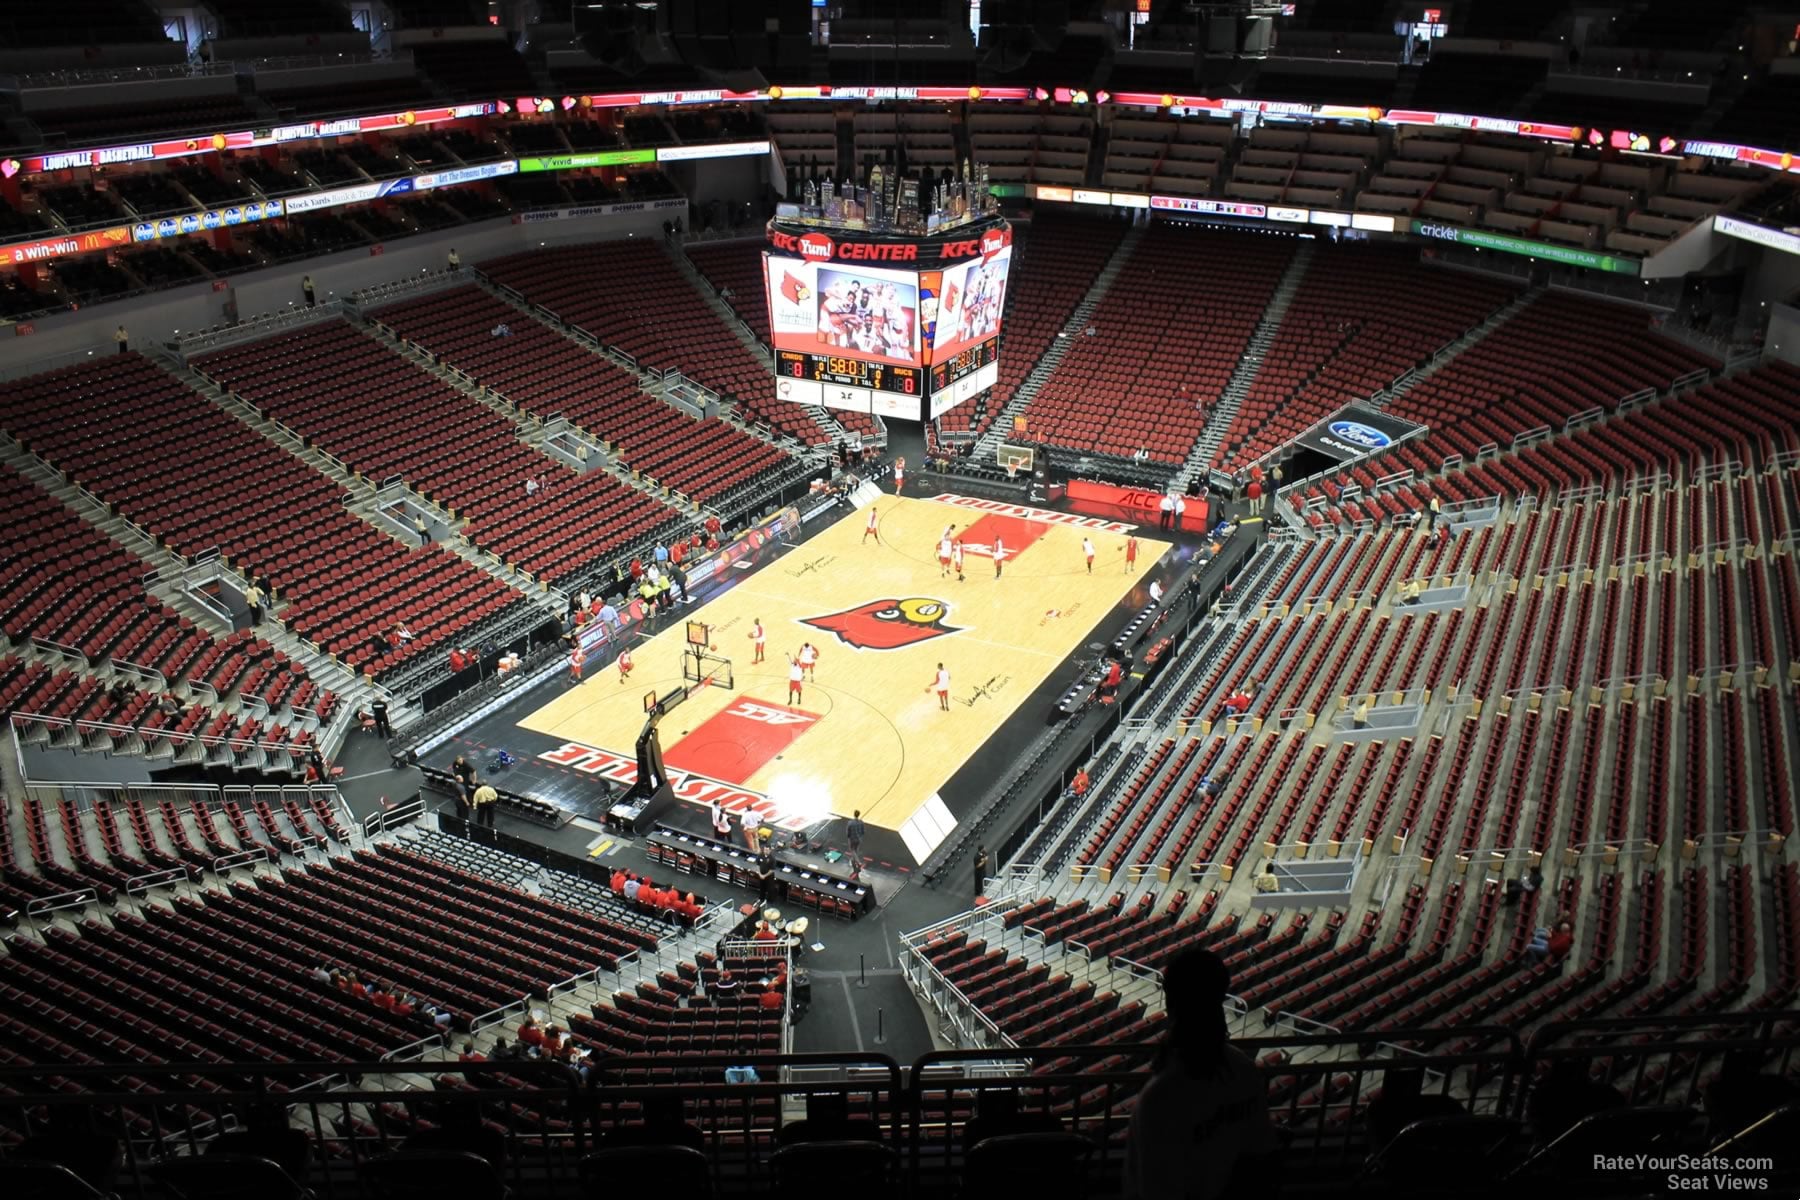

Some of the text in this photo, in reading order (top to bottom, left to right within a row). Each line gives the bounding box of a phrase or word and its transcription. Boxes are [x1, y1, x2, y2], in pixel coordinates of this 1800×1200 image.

[277, 119, 360, 141] LOUISVILLE BASKETBALL
[1477, 118, 1519, 133] BASKETBALL
[43, 145, 155, 171] LOUISVILLE BASKETBALL
[1684, 142, 1738, 159] BASKETBALL
[288, 200, 310, 209] Stock
[310, 197, 331, 207] Yards
[15, 249, 24, 261] a
[25, 238, 79, 260] win-win
[773, 231, 918, 261] KFC Yum! CENTER
[940, 240, 979, 258] KFC
[1420, 224, 1459, 241] cricket
[1463, 233, 1495, 244] UNLIMITED
[1496, 239, 1514, 248] MUSIC
[1526, 245, 1544, 254] YOUR
[1545, 248, 1577, 260] WIRELESS
[1577, 255, 1596, 264] PLAN
[829, 357, 865, 376] 58:01
[1338, 424, 1381, 445] Ford
[1118, 492, 1155, 509] ACC
[927, 493, 1138, 534] LOUISVILLE
[726, 702, 817, 725] ACC
